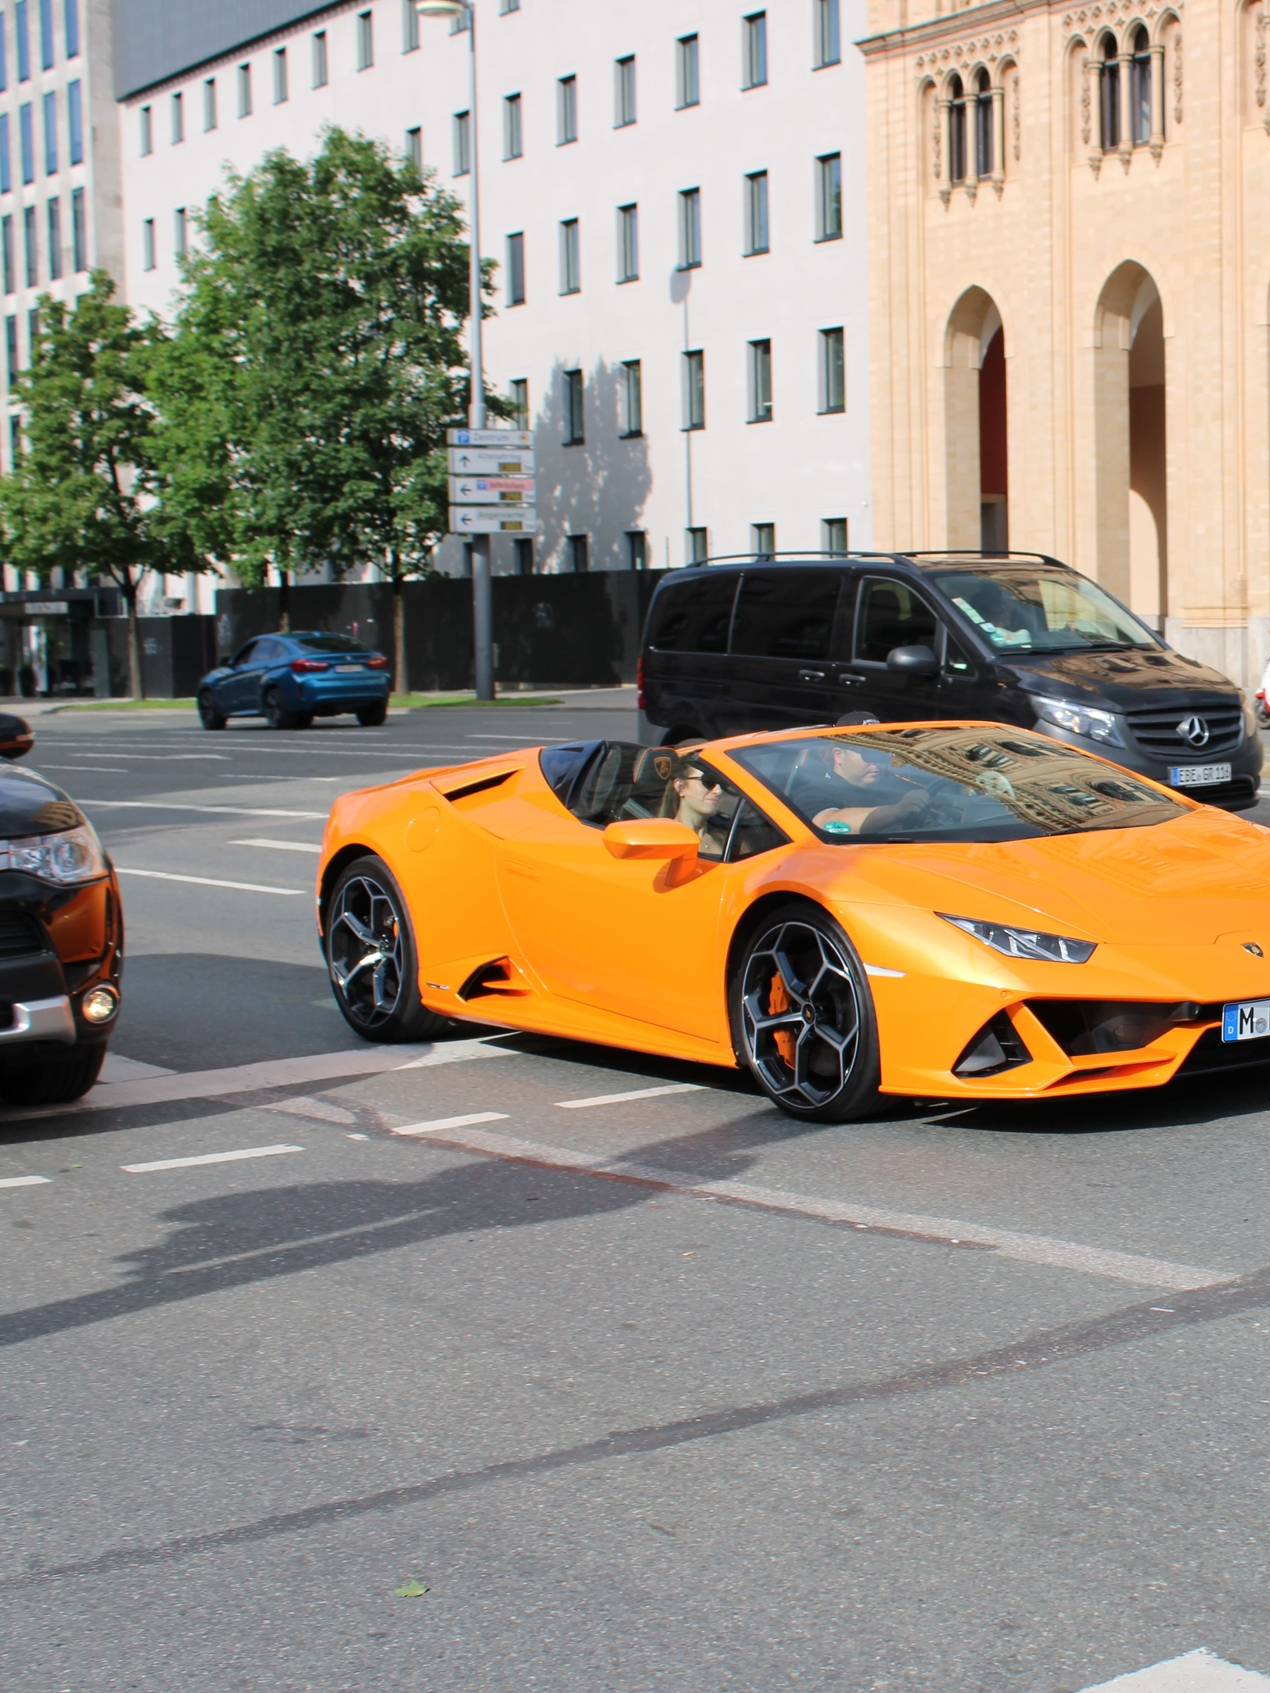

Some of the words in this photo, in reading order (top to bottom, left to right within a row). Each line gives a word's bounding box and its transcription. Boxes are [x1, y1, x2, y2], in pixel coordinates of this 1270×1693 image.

[473, 433, 509, 441] Zentrum
[1180, 769, 1196, 782] EBE
[1227, 1026, 1235, 1035] D
[1239, 1007, 1254, 1035] M
